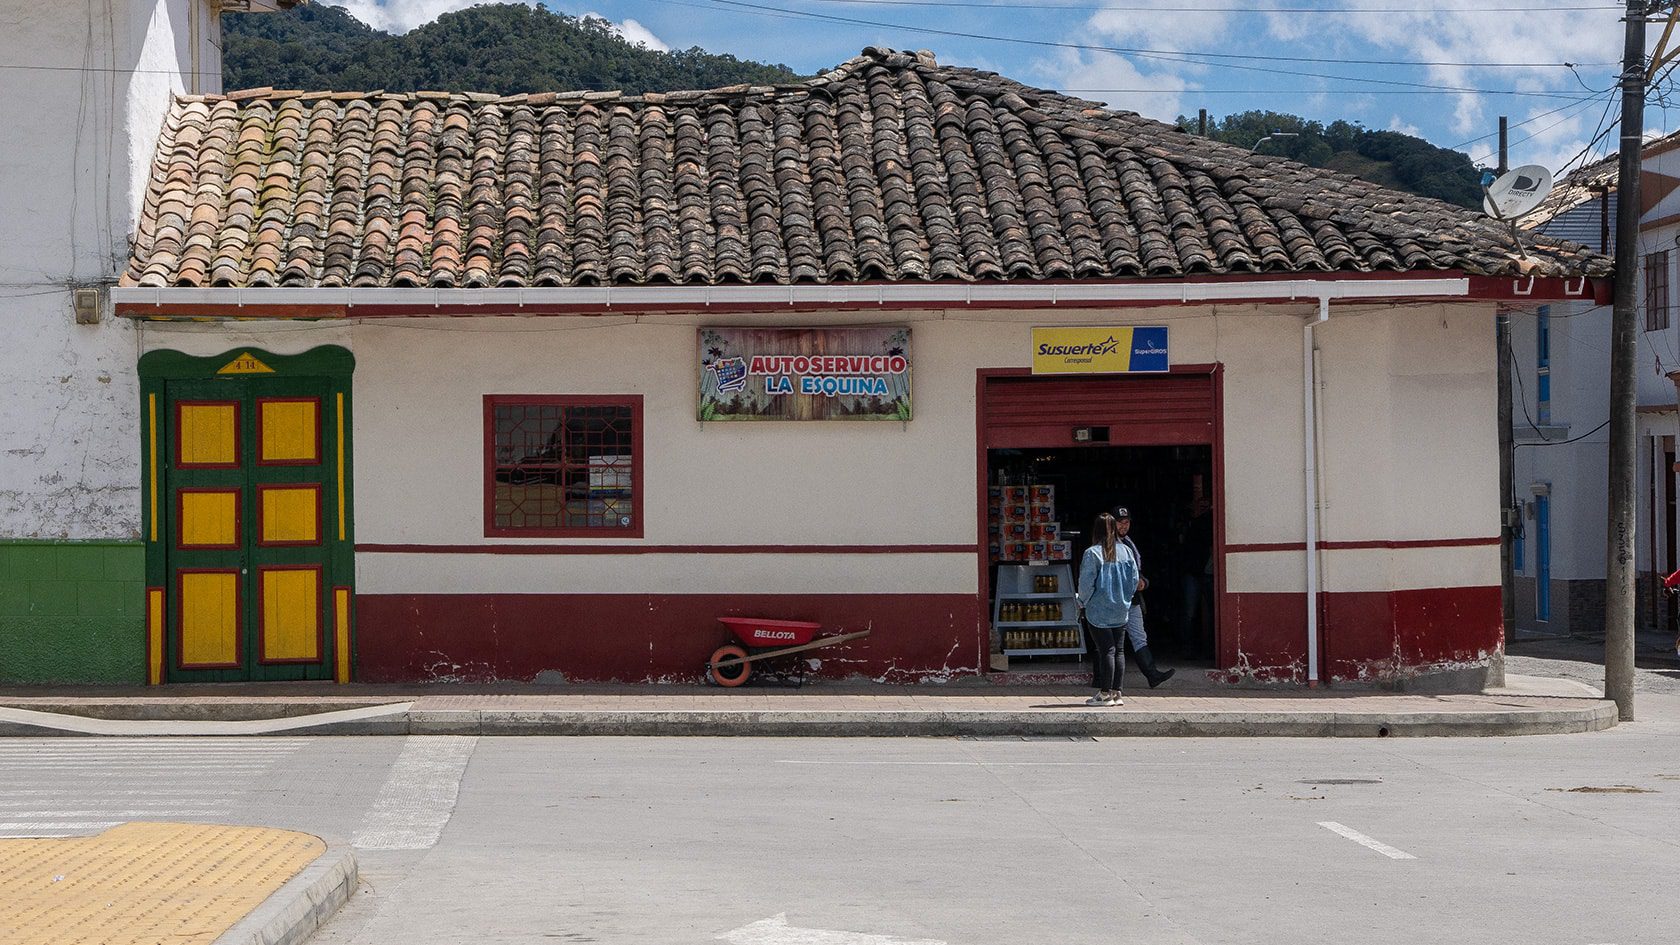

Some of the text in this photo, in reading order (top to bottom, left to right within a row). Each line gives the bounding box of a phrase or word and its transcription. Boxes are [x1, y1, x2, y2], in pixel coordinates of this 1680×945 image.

[1038, 343, 1102, 355] Susuerte
[235, 361, 241, 369] 4
[750, 356, 907, 374] AUTOSERVICIO
[766, 377, 888, 396] LA ESQUINA
[754, 629, 796, 640] BELLOTA
